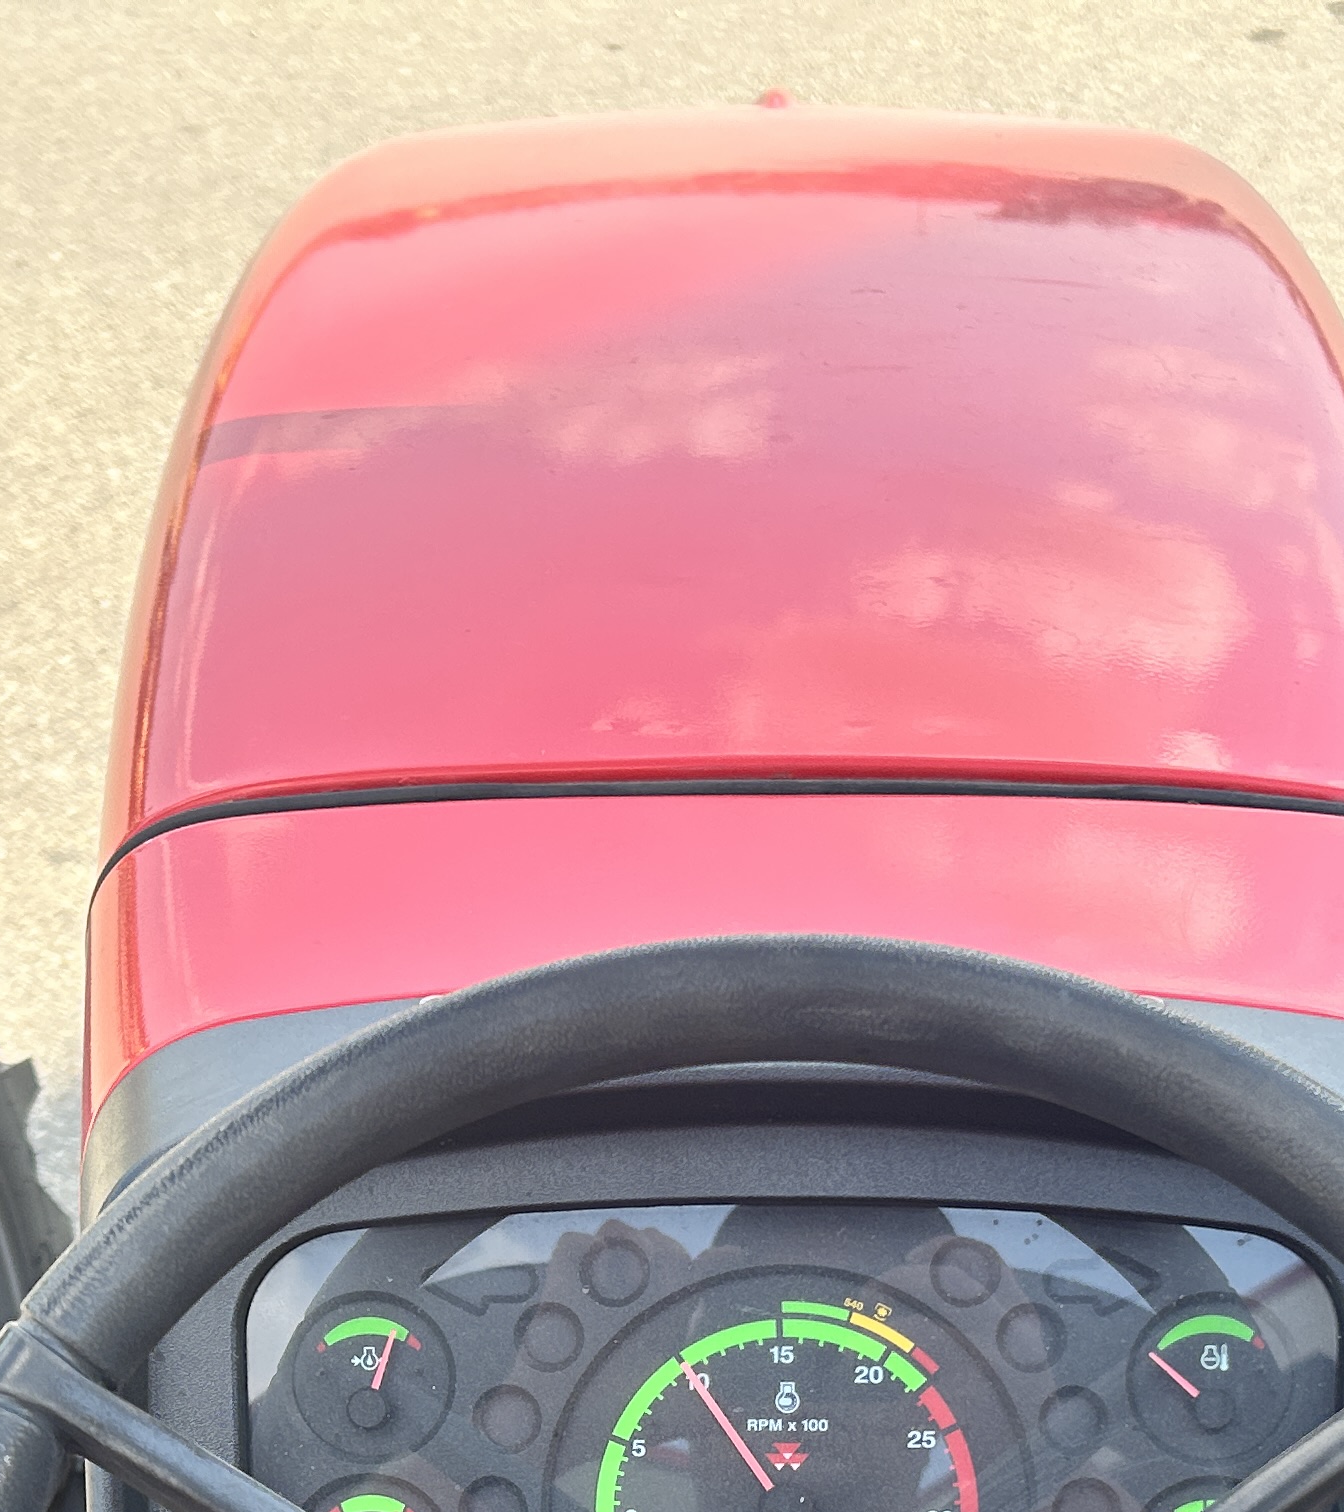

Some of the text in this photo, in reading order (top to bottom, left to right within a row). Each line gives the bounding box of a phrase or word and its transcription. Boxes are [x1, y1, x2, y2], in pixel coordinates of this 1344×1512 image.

[769, 1346, 794, 1364] 15
[854, 1366, 884, 1384] 20
[746, 1418, 784, 1433] RPM
[801, 1418, 829, 1432] 100
[631, 1440, 646, 1458] 5
[907, 1431, 936, 1449] 25
